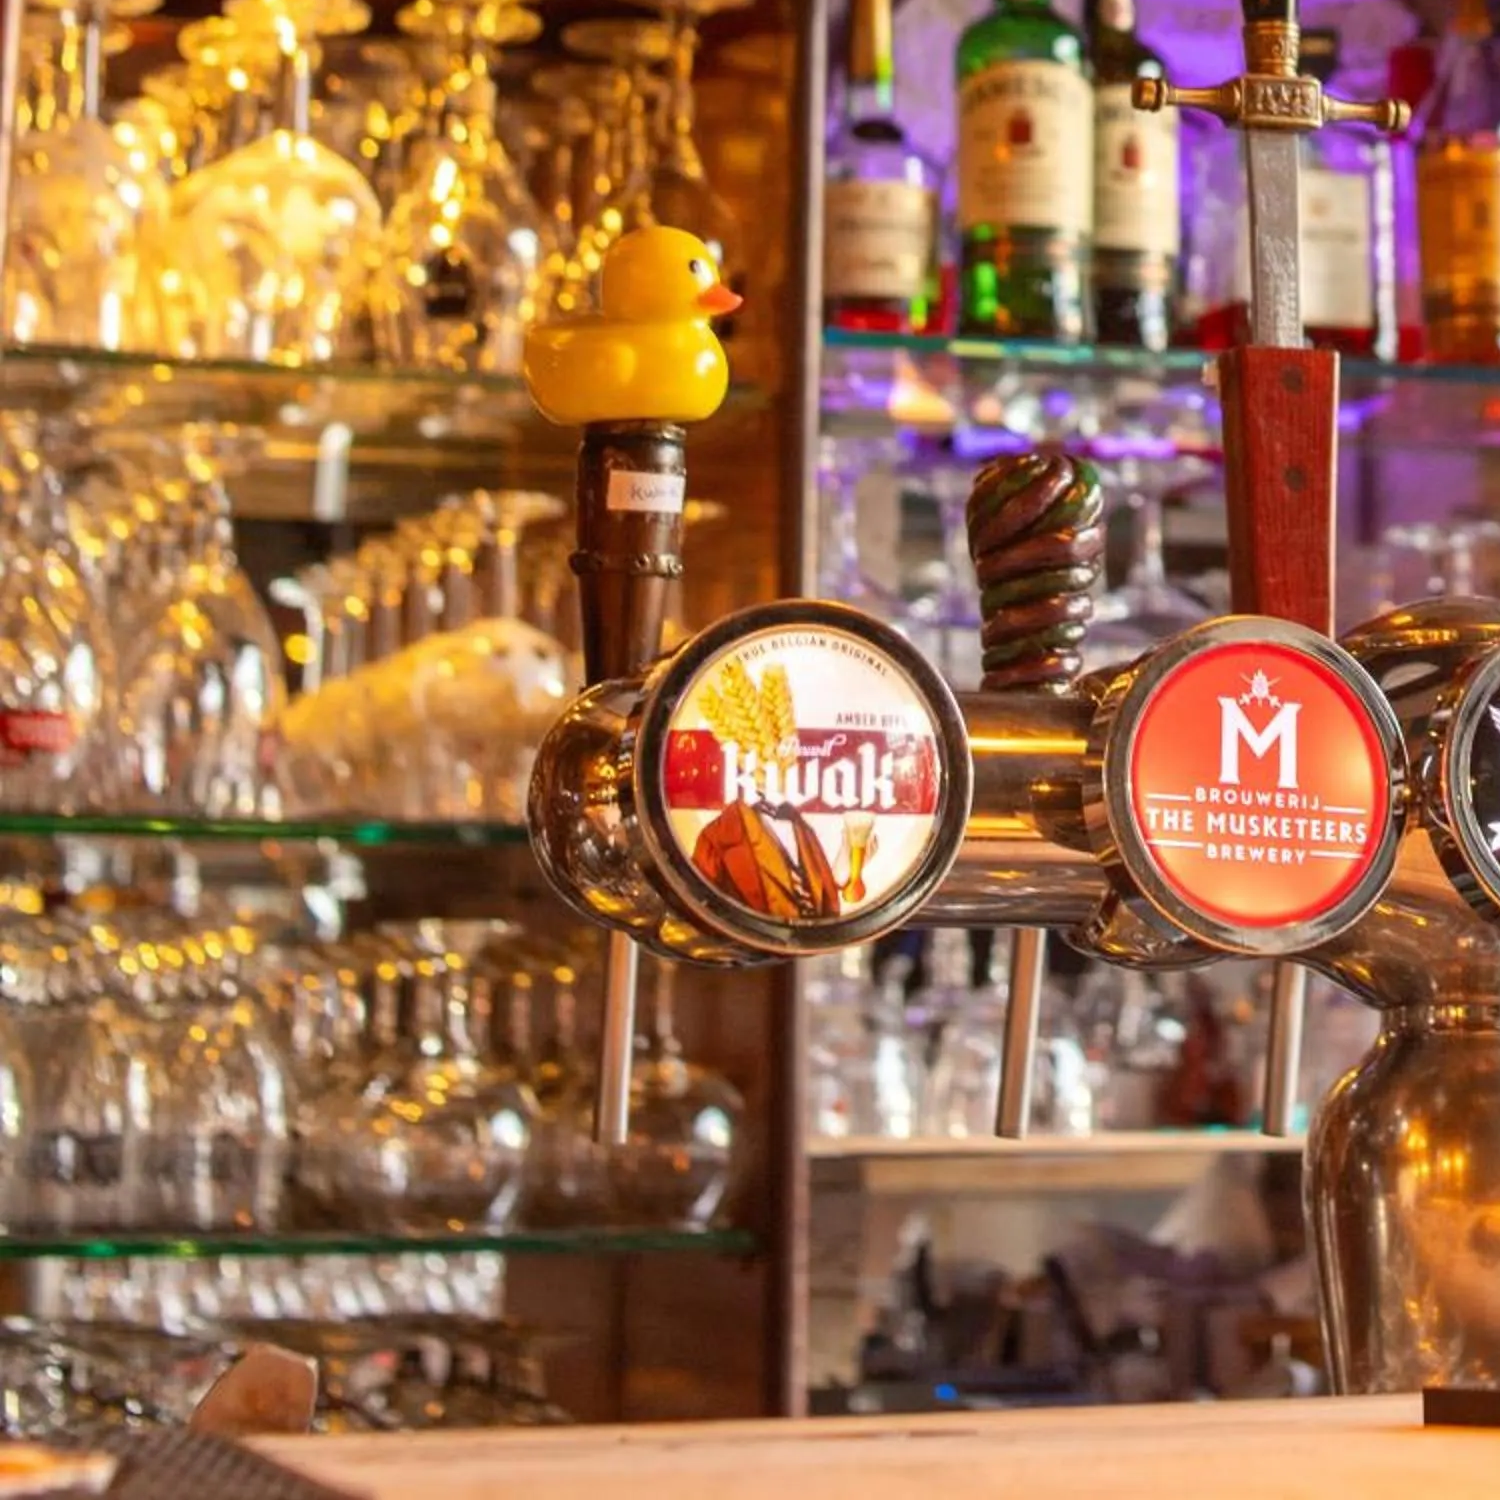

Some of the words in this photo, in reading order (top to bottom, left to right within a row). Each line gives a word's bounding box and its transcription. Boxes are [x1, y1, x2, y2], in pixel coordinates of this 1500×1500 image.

[831, 640, 888, 678] ORIGINAL
[1217, 696, 1303, 789] M
[1195, 785, 1320, 812] BROUWERIJ
[1145, 806, 1195, 832] THE
[1205, 810, 1368, 845] MUSKETEERS
[1206, 842, 1308, 866] BREWERY
